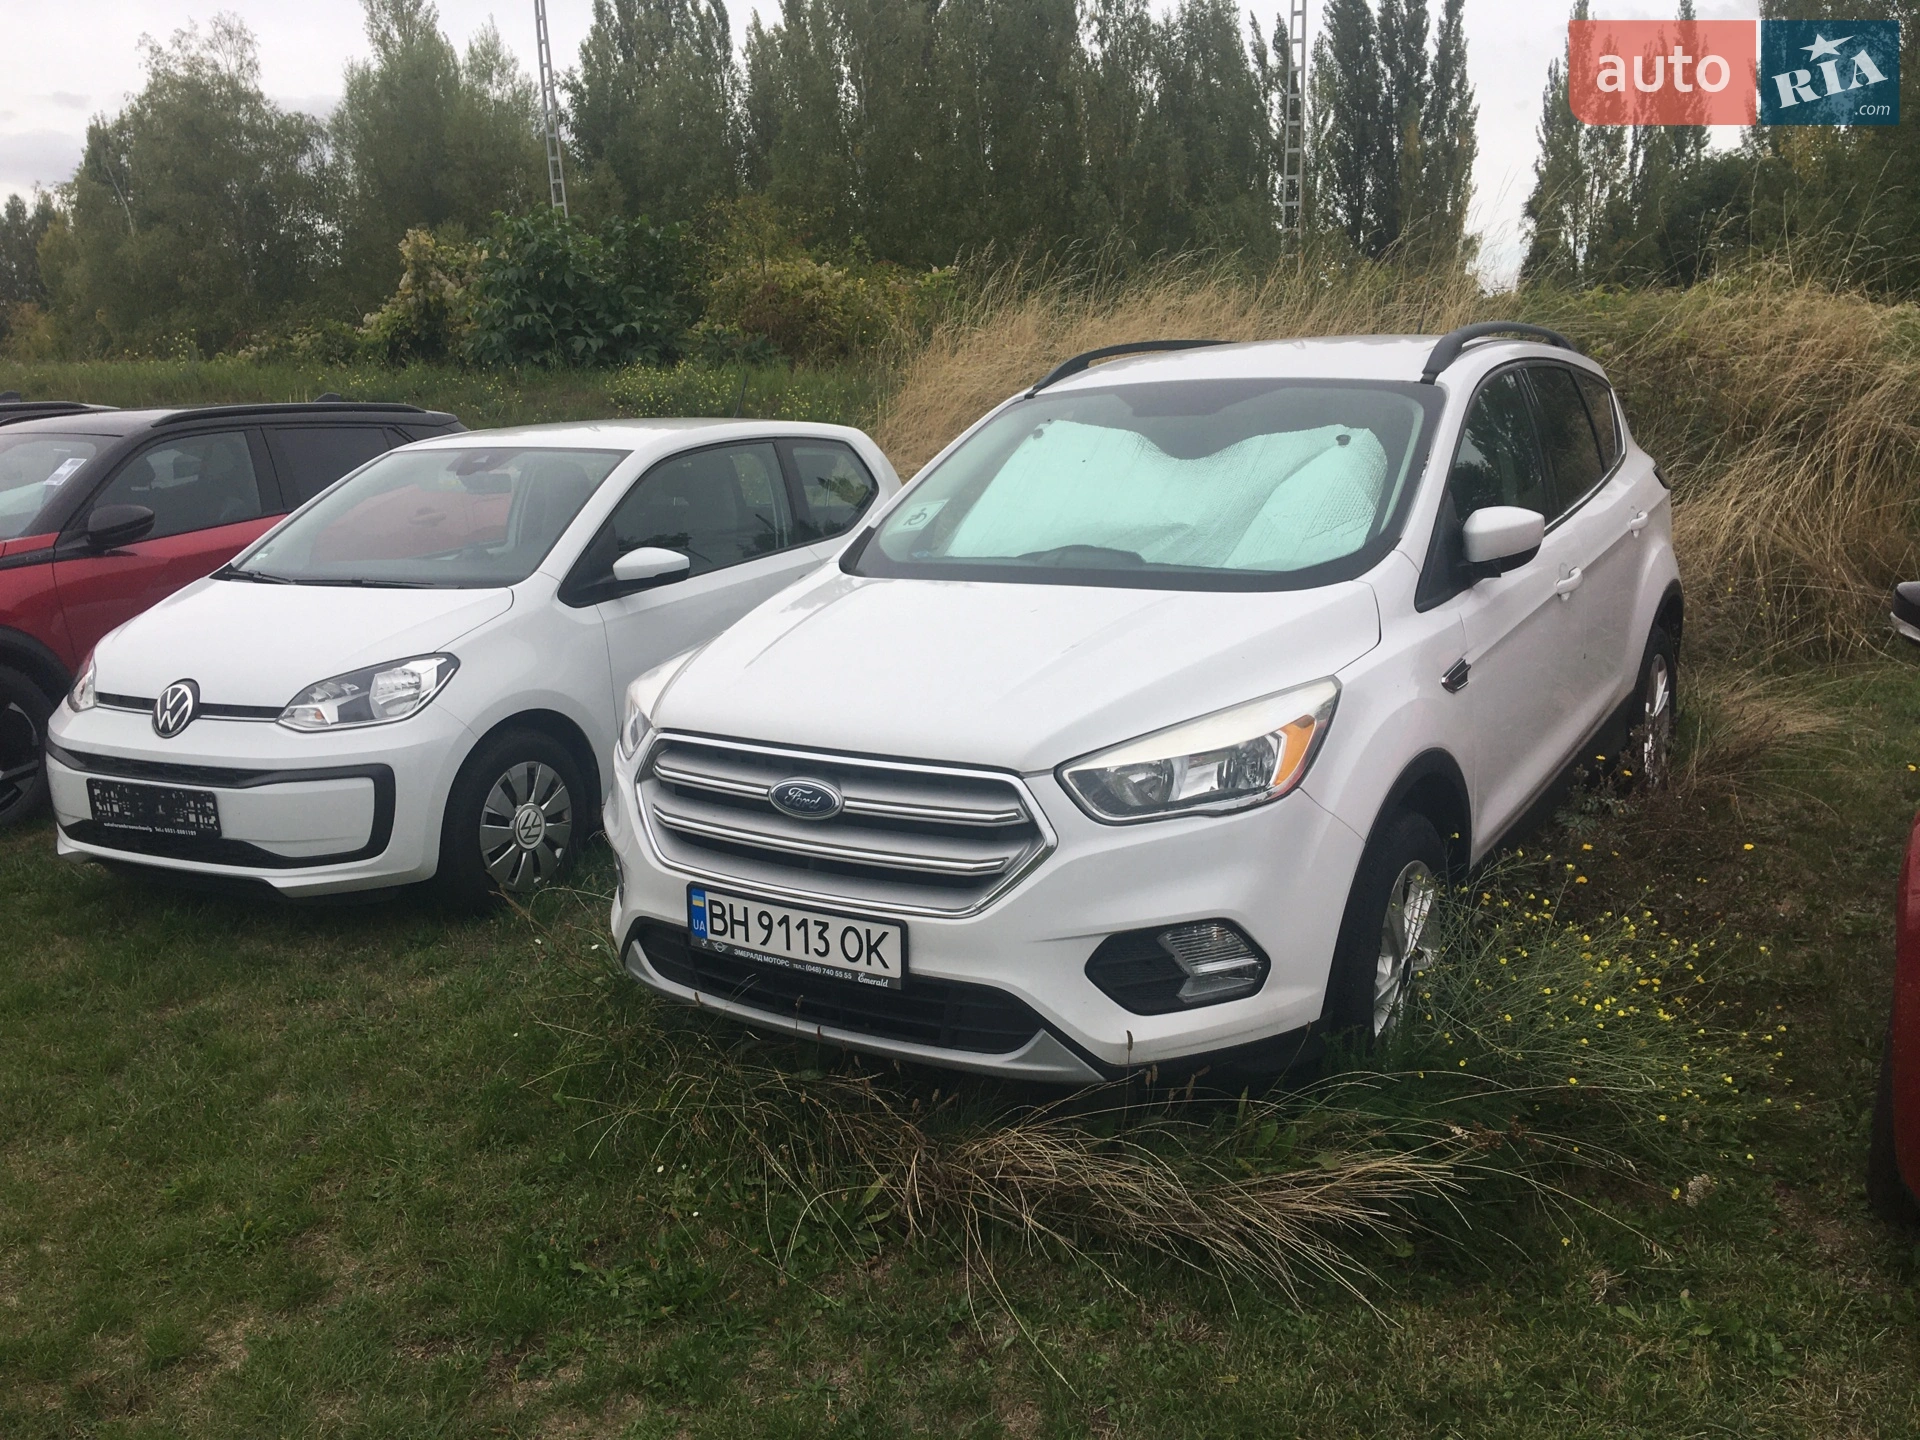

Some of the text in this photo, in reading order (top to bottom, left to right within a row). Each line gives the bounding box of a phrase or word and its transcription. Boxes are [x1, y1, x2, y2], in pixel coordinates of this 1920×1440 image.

[784, 787, 822, 809] Ford
[693, 919, 705, 932] UA
[708, 899, 890, 969] BH 9113 OK
[733, 949, 763, 961] ЭМЕРАЛД
[763, 955, 790, 967] МОТОРС
[805, 964, 822, 974] (048)
[822, 968, 834, 977] 740
[834, 970, 843, 978] 55
[843, 972, 853, 980] 55
[857, 972, 889, 988] Emerald
